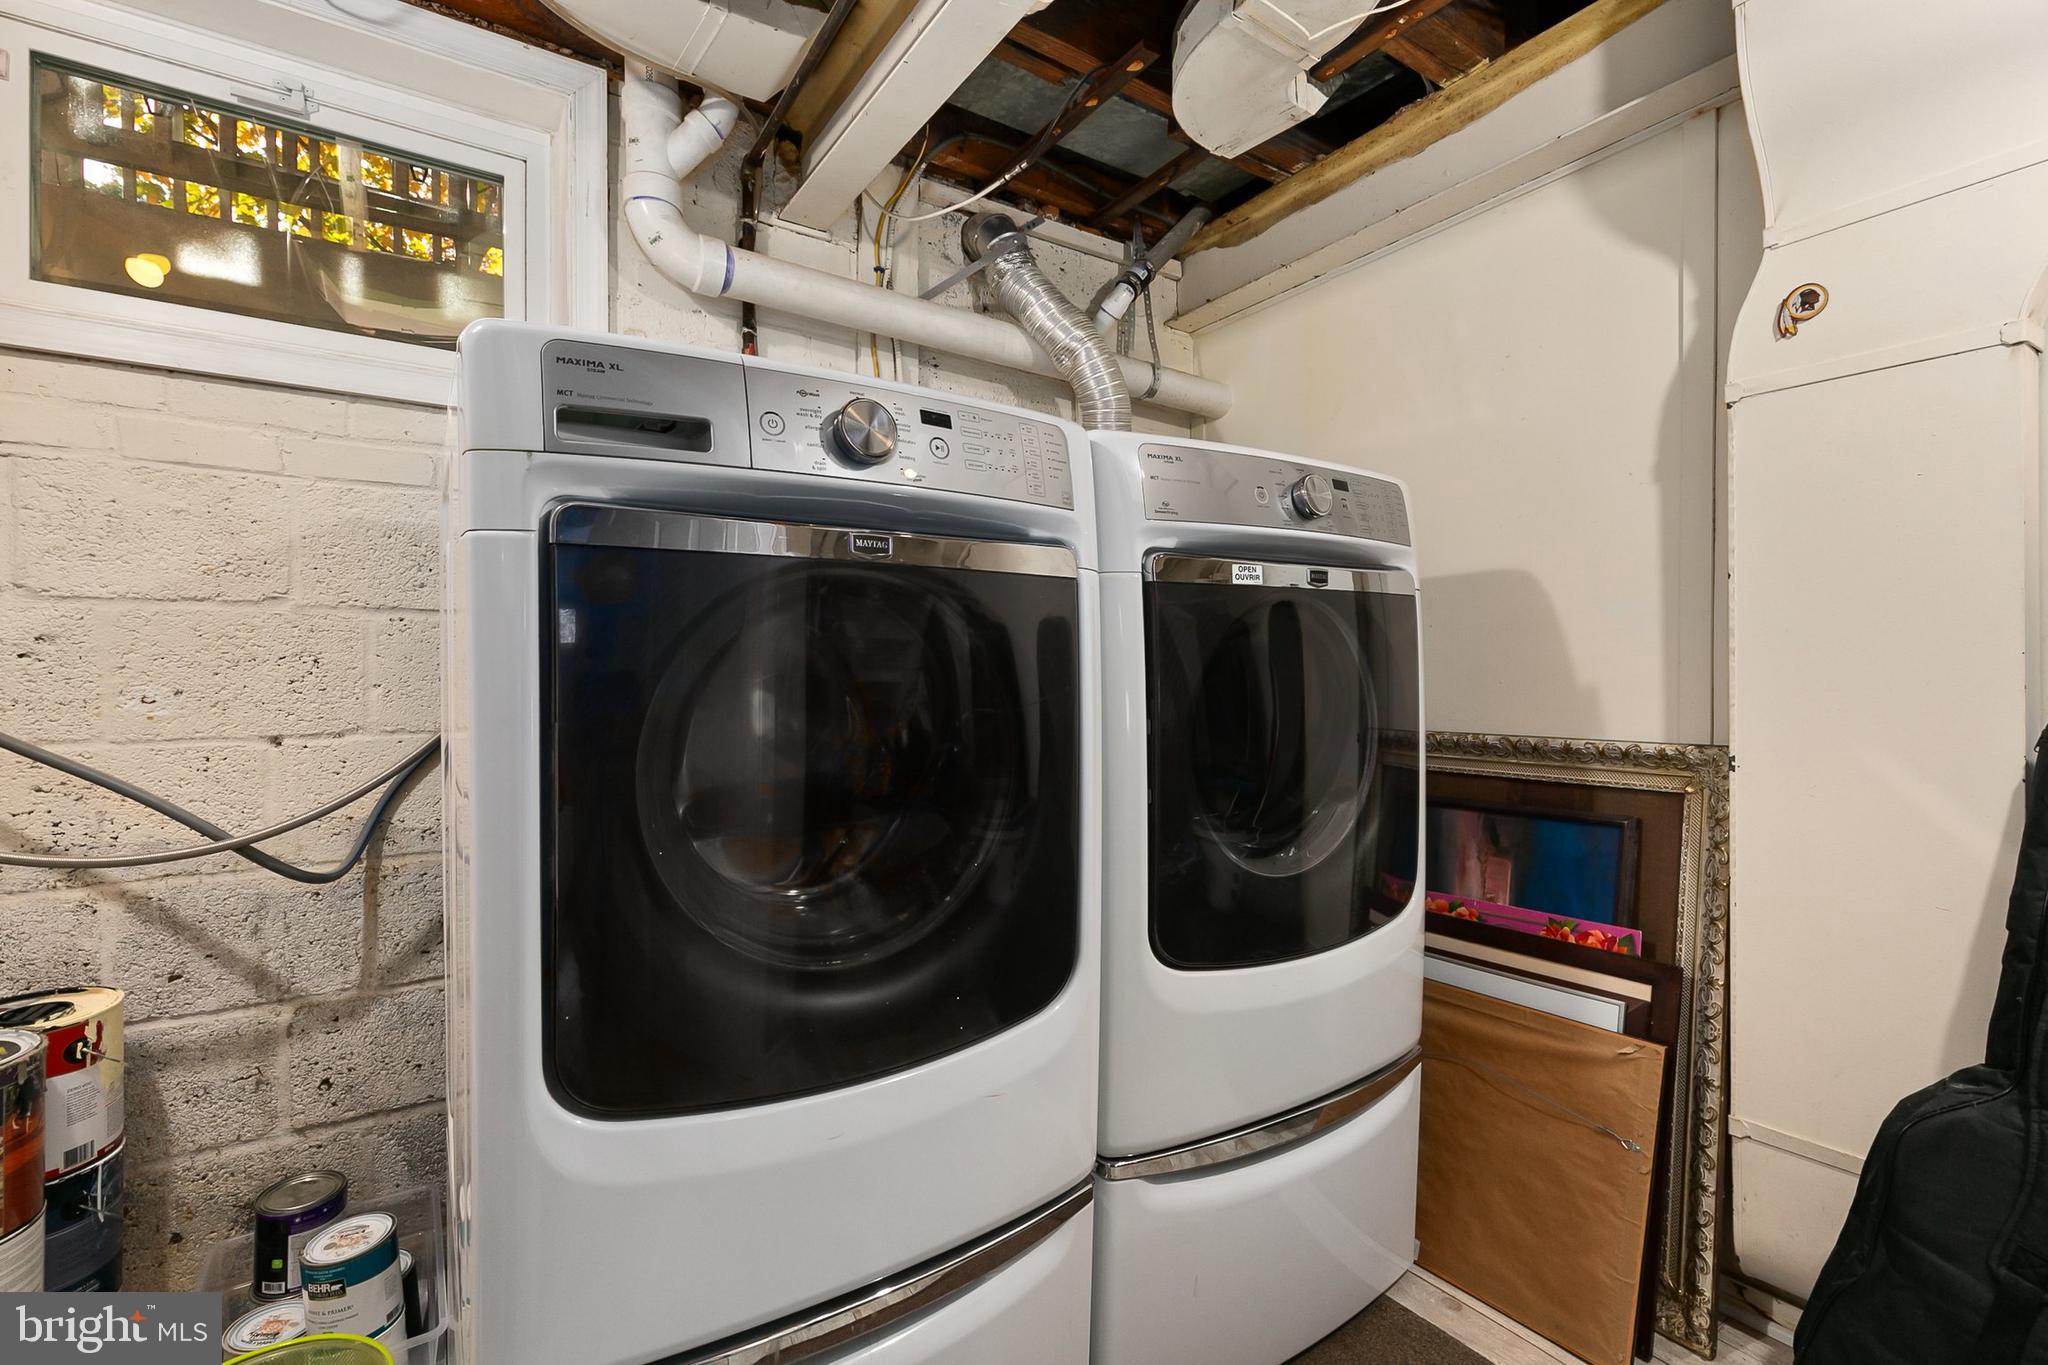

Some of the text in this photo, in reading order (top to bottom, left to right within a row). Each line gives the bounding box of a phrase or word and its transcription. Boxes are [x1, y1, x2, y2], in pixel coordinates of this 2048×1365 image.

[556, 356, 624, 371] MAXIMA XL
[556, 389, 574, 397] MCT
[855, 539, 888, 549] MAYTAG
[1234, 573, 1260, 581] OUVRIR
[308, 1283, 330, 1293] BEHR
